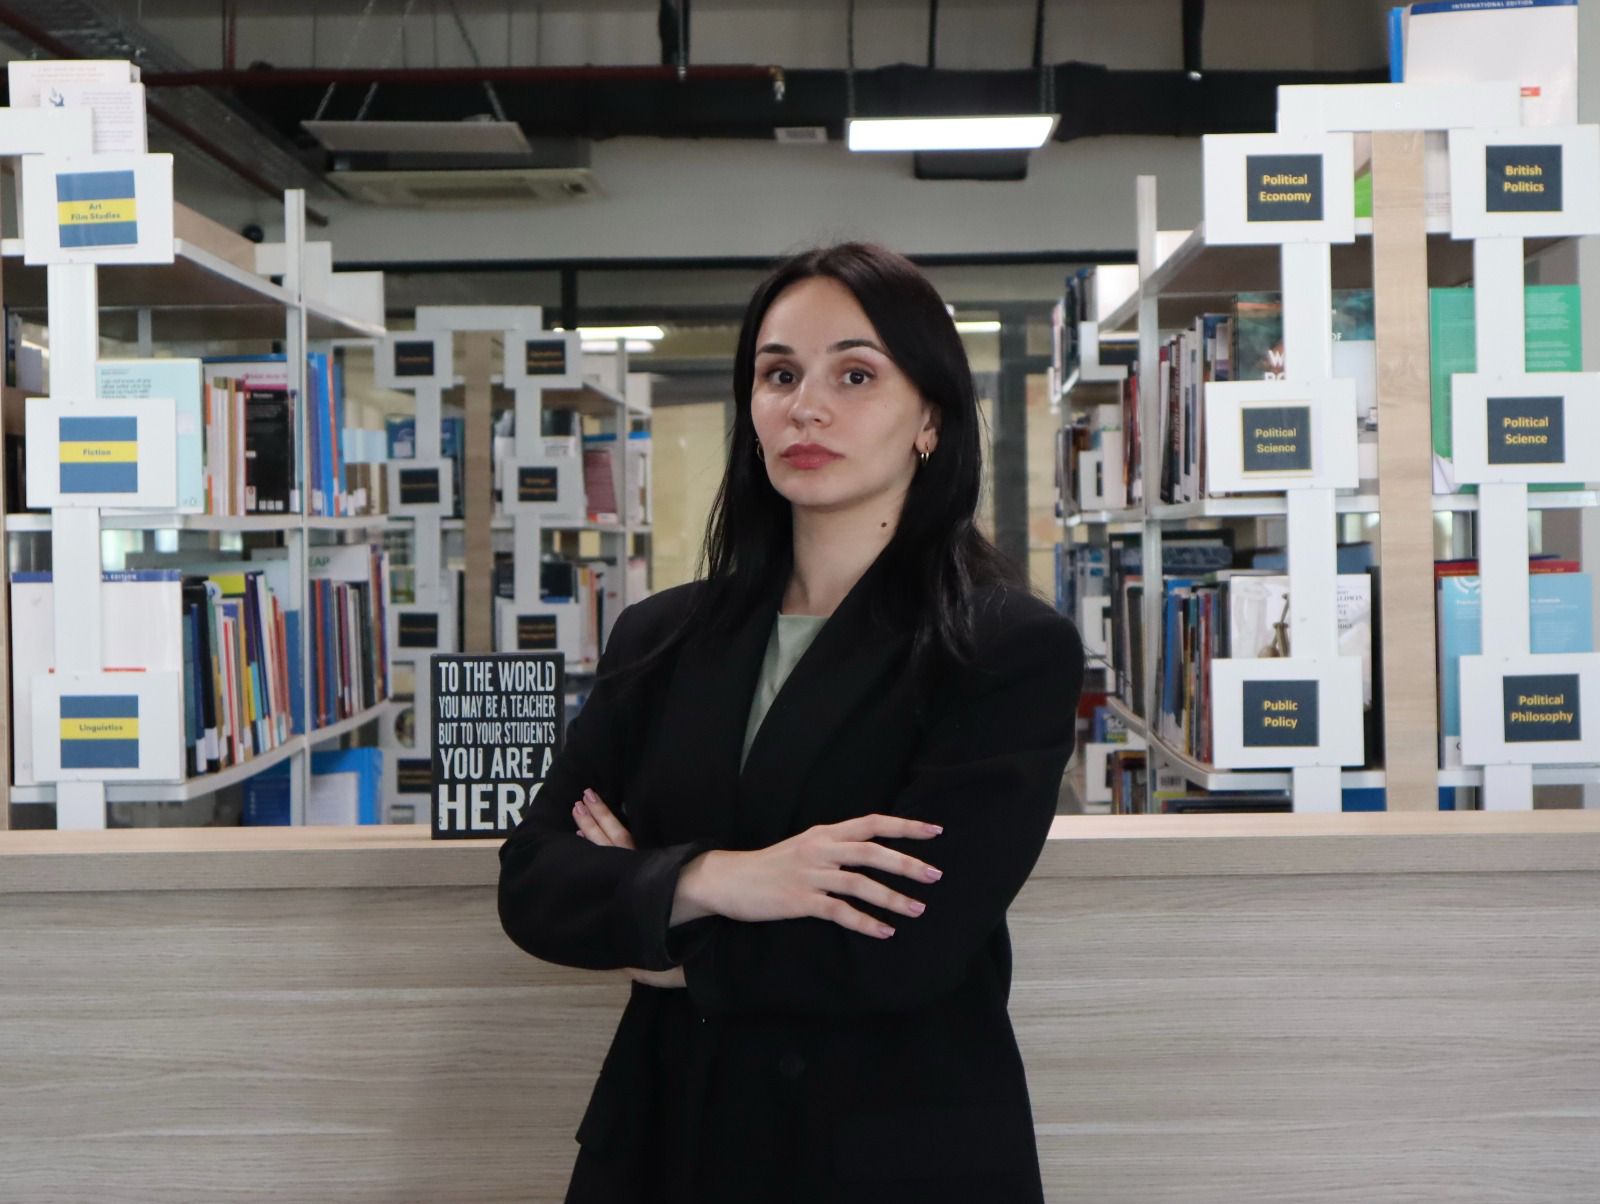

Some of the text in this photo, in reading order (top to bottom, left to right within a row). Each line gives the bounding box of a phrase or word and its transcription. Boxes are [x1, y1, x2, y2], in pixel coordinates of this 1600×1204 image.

[1451, 1, 1504, 9] INTERNATIONAL
[1505, 164, 1542, 176] British
[1262, 173, 1308, 185] Political
[1503, 181, 1545, 192] Politics
[1259, 191, 1312, 204] Economy
[71, 212, 120, 221] Film Studies
[1503, 416, 1549, 428] Political
[1255, 427, 1297, 438] Political
[1505, 433, 1548, 444] Science
[83, 448, 112, 456] Fiction
[1257, 443, 1297, 453] Science
[438, 660, 556, 693] TO THE WORLD
[1264, 700, 1299, 710] Public
[1518, 693, 1564, 706] Political
[438, 694, 556, 718] YOU MAY BE A TEACHER
[1264, 716, 1298, 729] Policy
[1511, 710, 1574, 724] Philosophy
[79, 724, 123, 732] Linguistics
[438, 721, 556, 745] BUT TO YOUR STUDENTS
[439, 747, 483, 779] YOU
[490, 746, 534, 779] ARE
[540, 746, 553, 779] A
